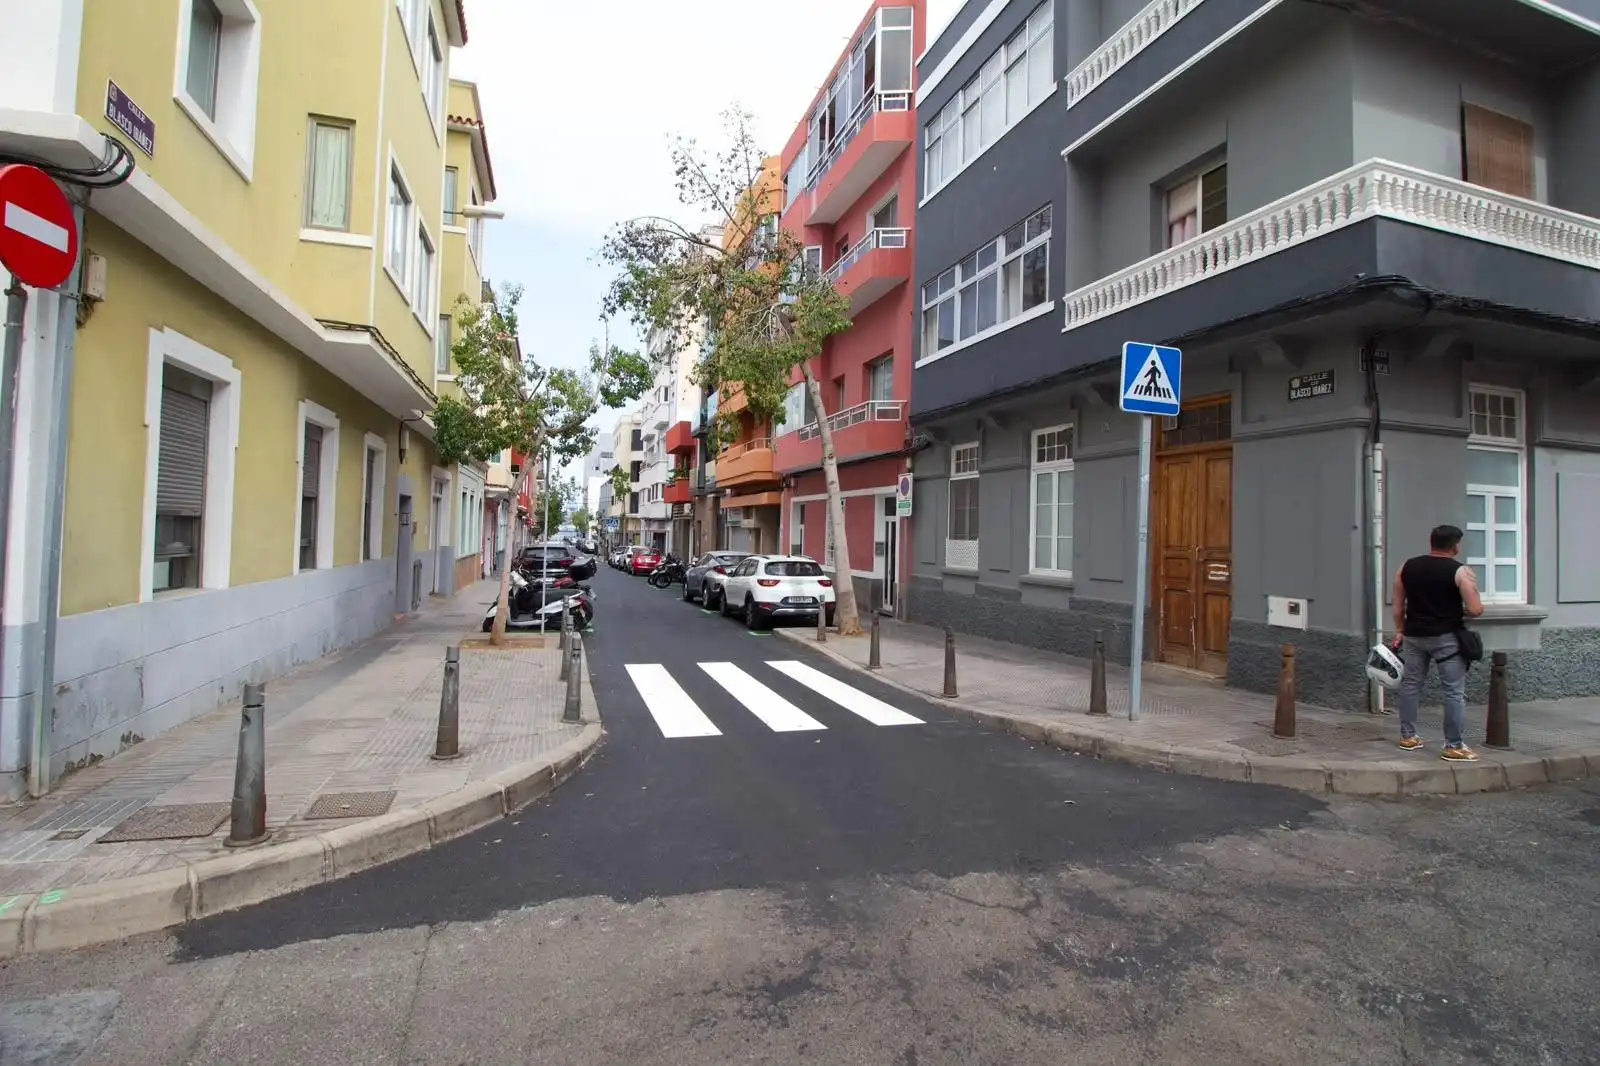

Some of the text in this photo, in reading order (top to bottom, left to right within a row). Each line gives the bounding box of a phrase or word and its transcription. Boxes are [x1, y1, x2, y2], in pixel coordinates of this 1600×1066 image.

[109, 103, 132, 135] BLASCO
[127, 101, 146, 124] CALLE
[1303, 372, 1328, 383] CALLE
[1290, 387, 1311, 399] BLASCO
